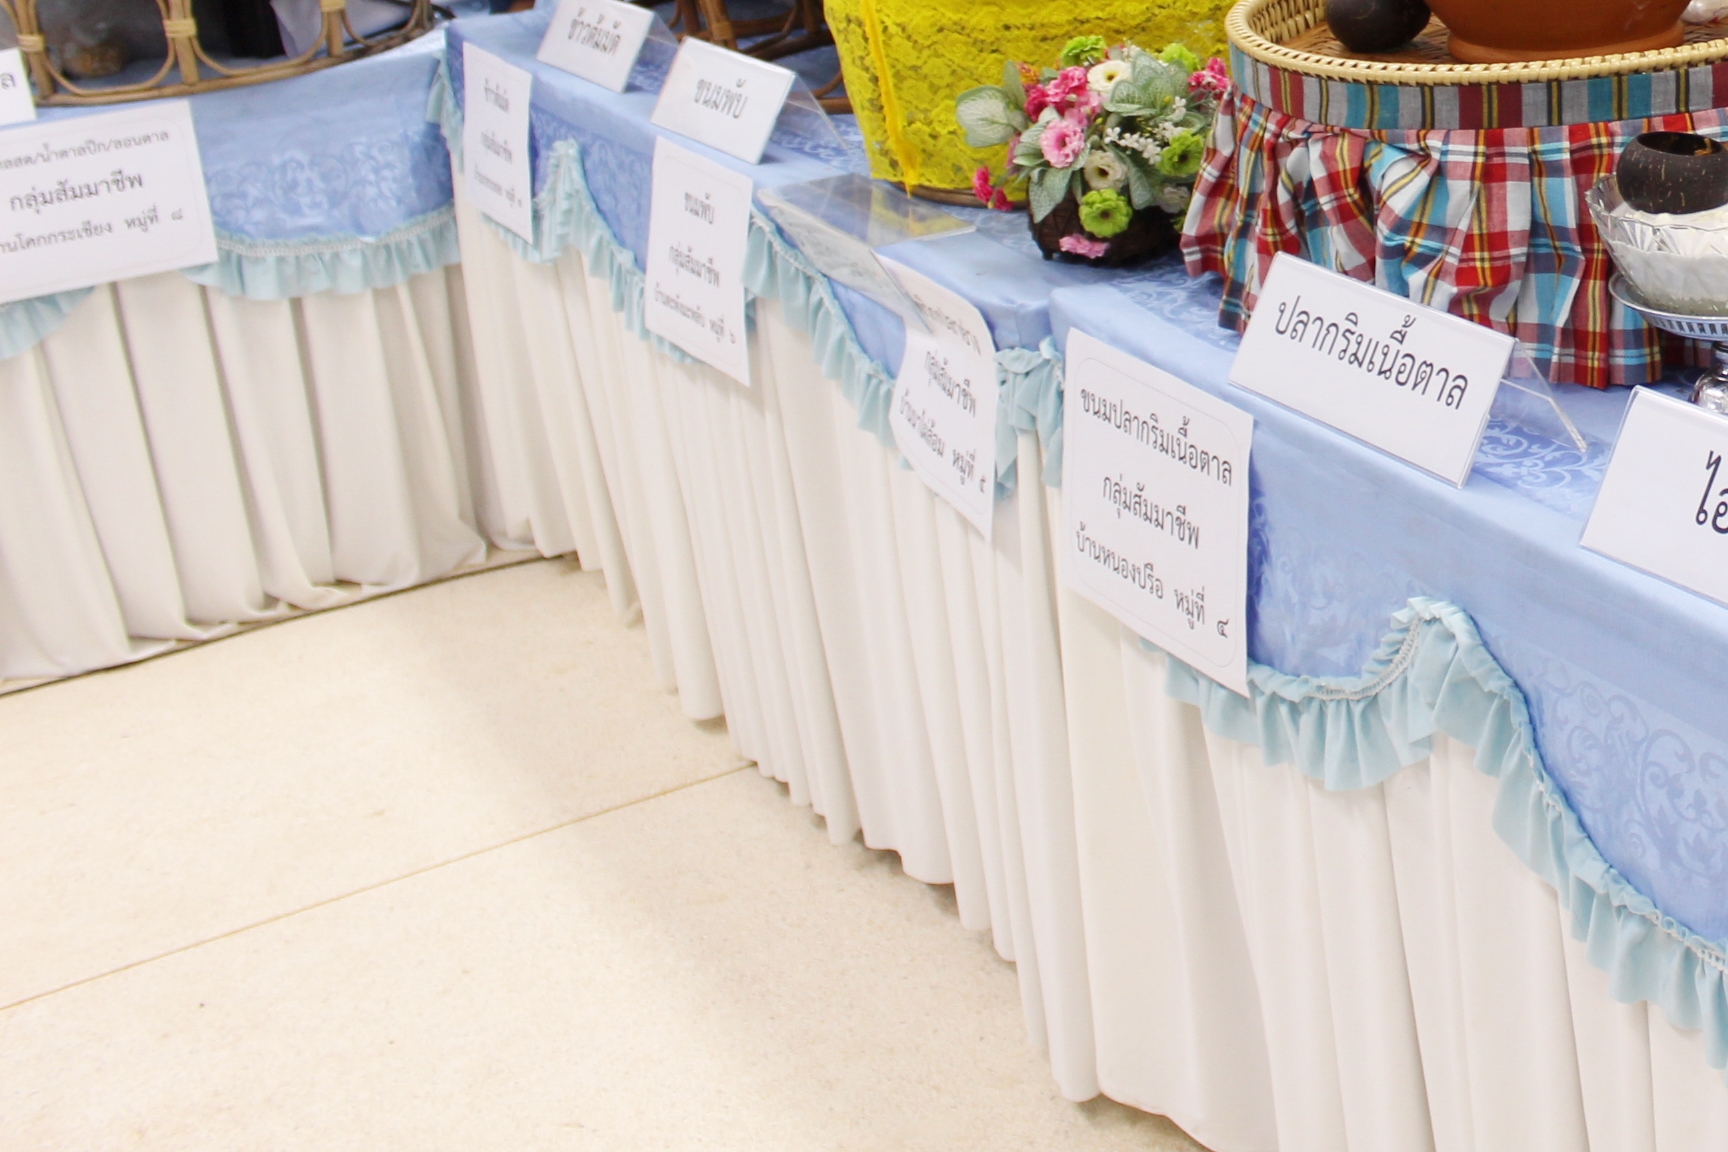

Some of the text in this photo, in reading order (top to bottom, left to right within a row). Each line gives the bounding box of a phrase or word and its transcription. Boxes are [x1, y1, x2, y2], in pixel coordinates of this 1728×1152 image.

[694, 78, 748, 119] ขนมพับ
[9, 169, 143, 215] กลุ่มสัมมาชีพ
[684, 192, 715, 225] ขนมพับ
[124, 203, 159, 234] หมู่ที่
[668, 241, 720, 288] กลุ่มสัมมาชีพ
[1274, 295, 1469, 411] ปลากริมเนื้อตาล
[924, 348, 977, 417] กลุ่มสัมมาชีพ
[1080, 387, 1233, 487] ขนมปลากริมเนื้อตาล
[952, 449, 977, 485] หมู่ที่
[1102, 474, 1200, 550] กลุ่มสัมมาชีพ
[1075, 521, 1230, 639] บ้านหนองปรือ หมู่ที่ ๔
